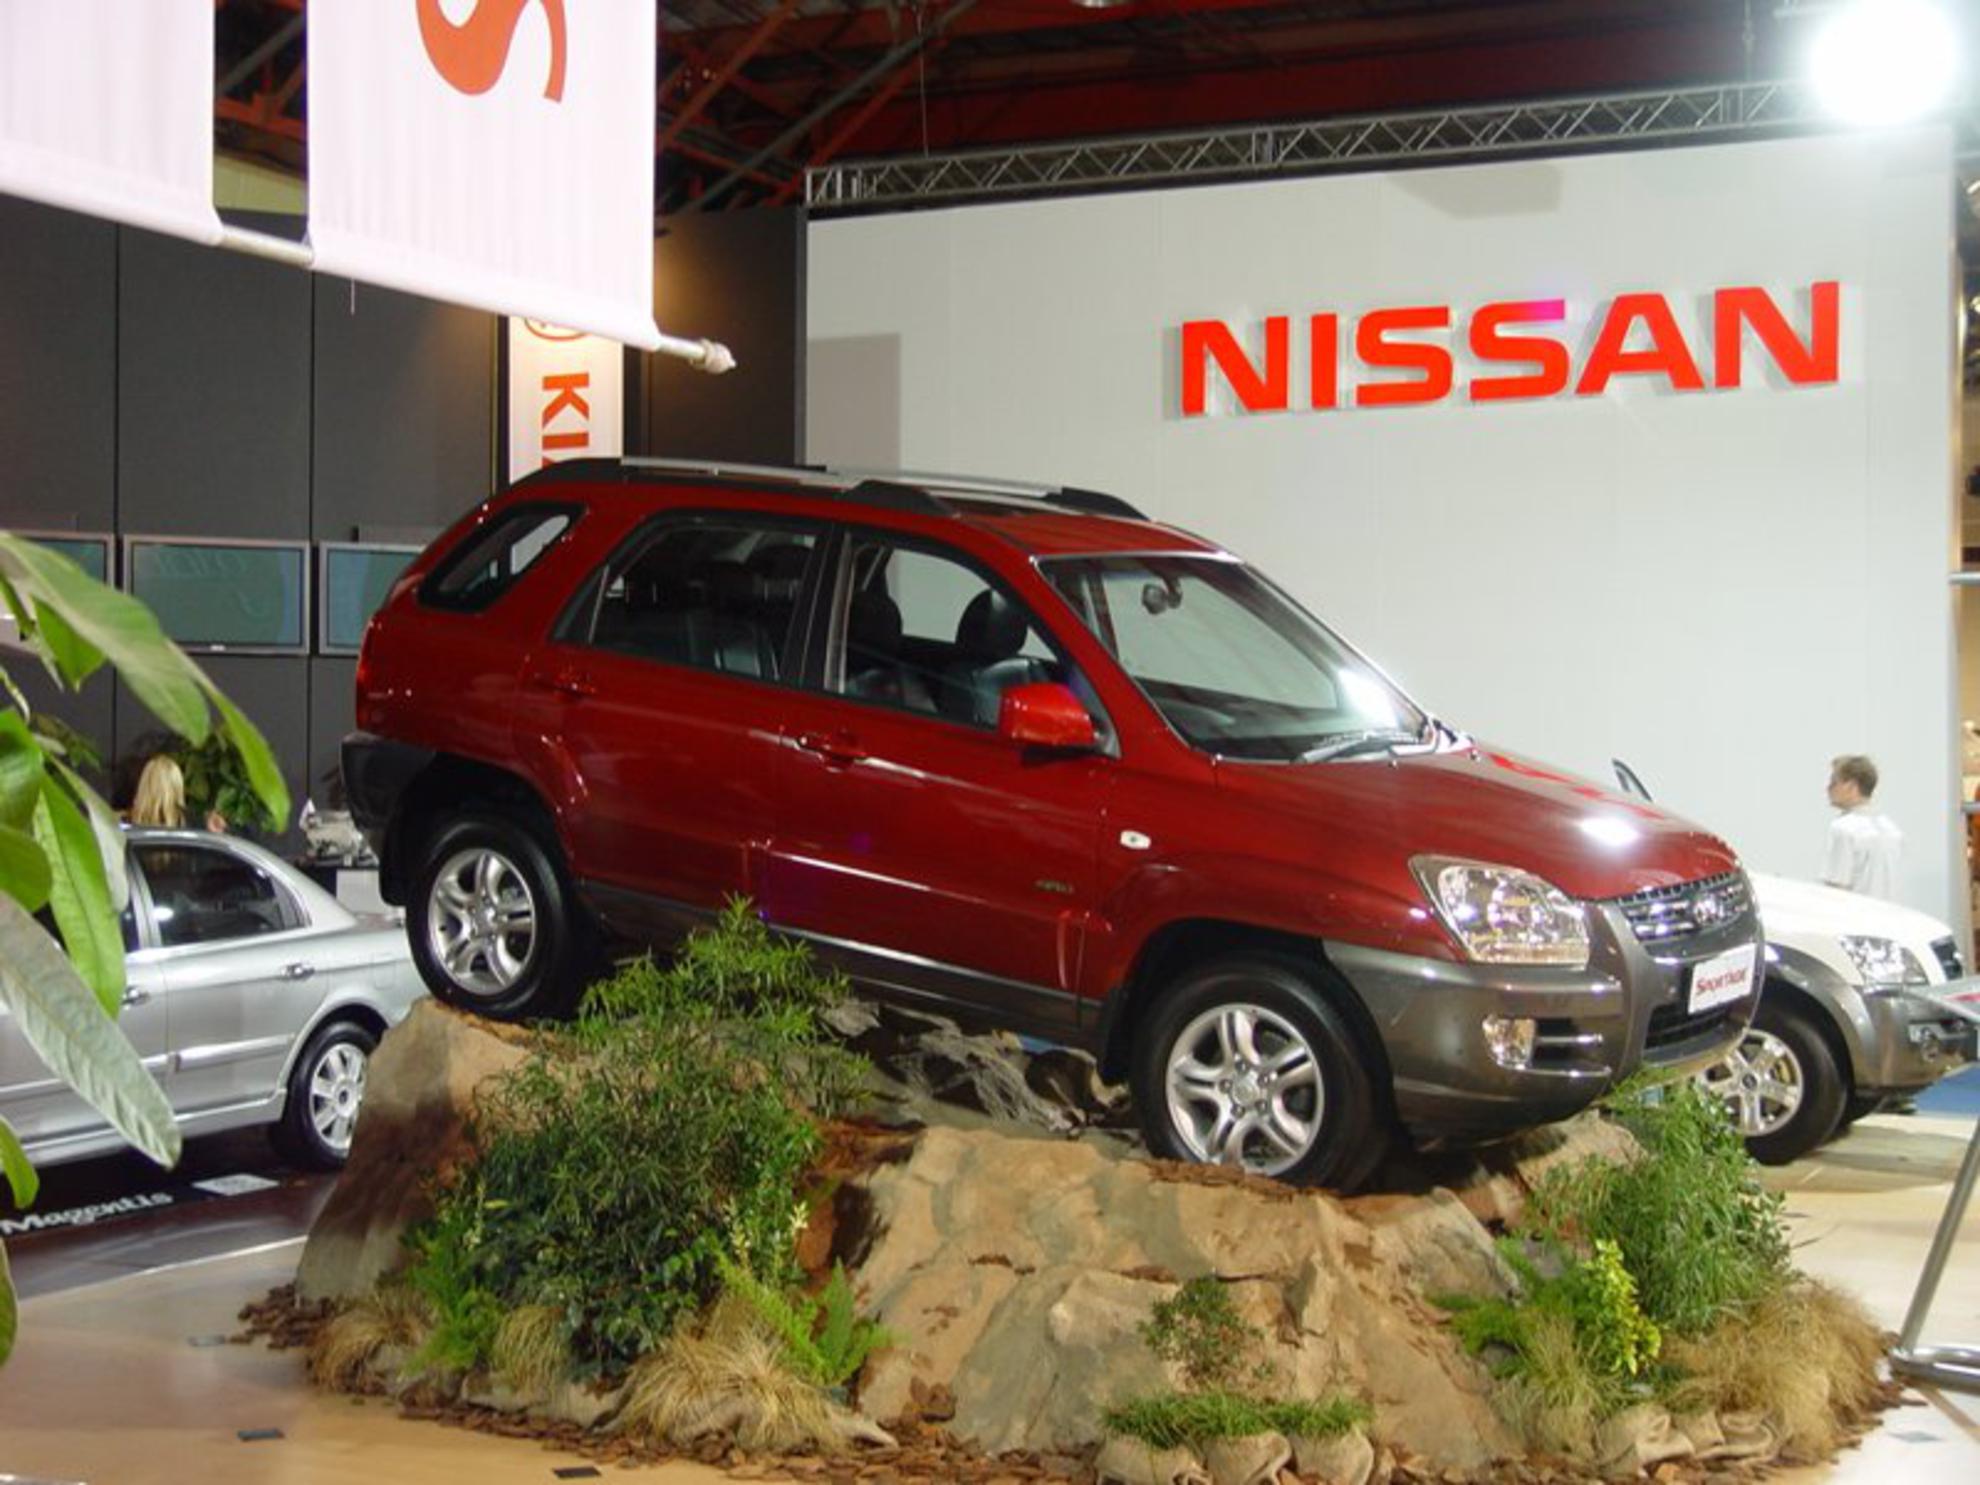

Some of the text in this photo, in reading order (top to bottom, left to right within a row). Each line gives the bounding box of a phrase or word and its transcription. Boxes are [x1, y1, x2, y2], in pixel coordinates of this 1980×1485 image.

[1182, 281, 1839, 415] NISSAN
[541, 372, 590, 469] KI
[0, 1191, 174, 1235] Magentis
